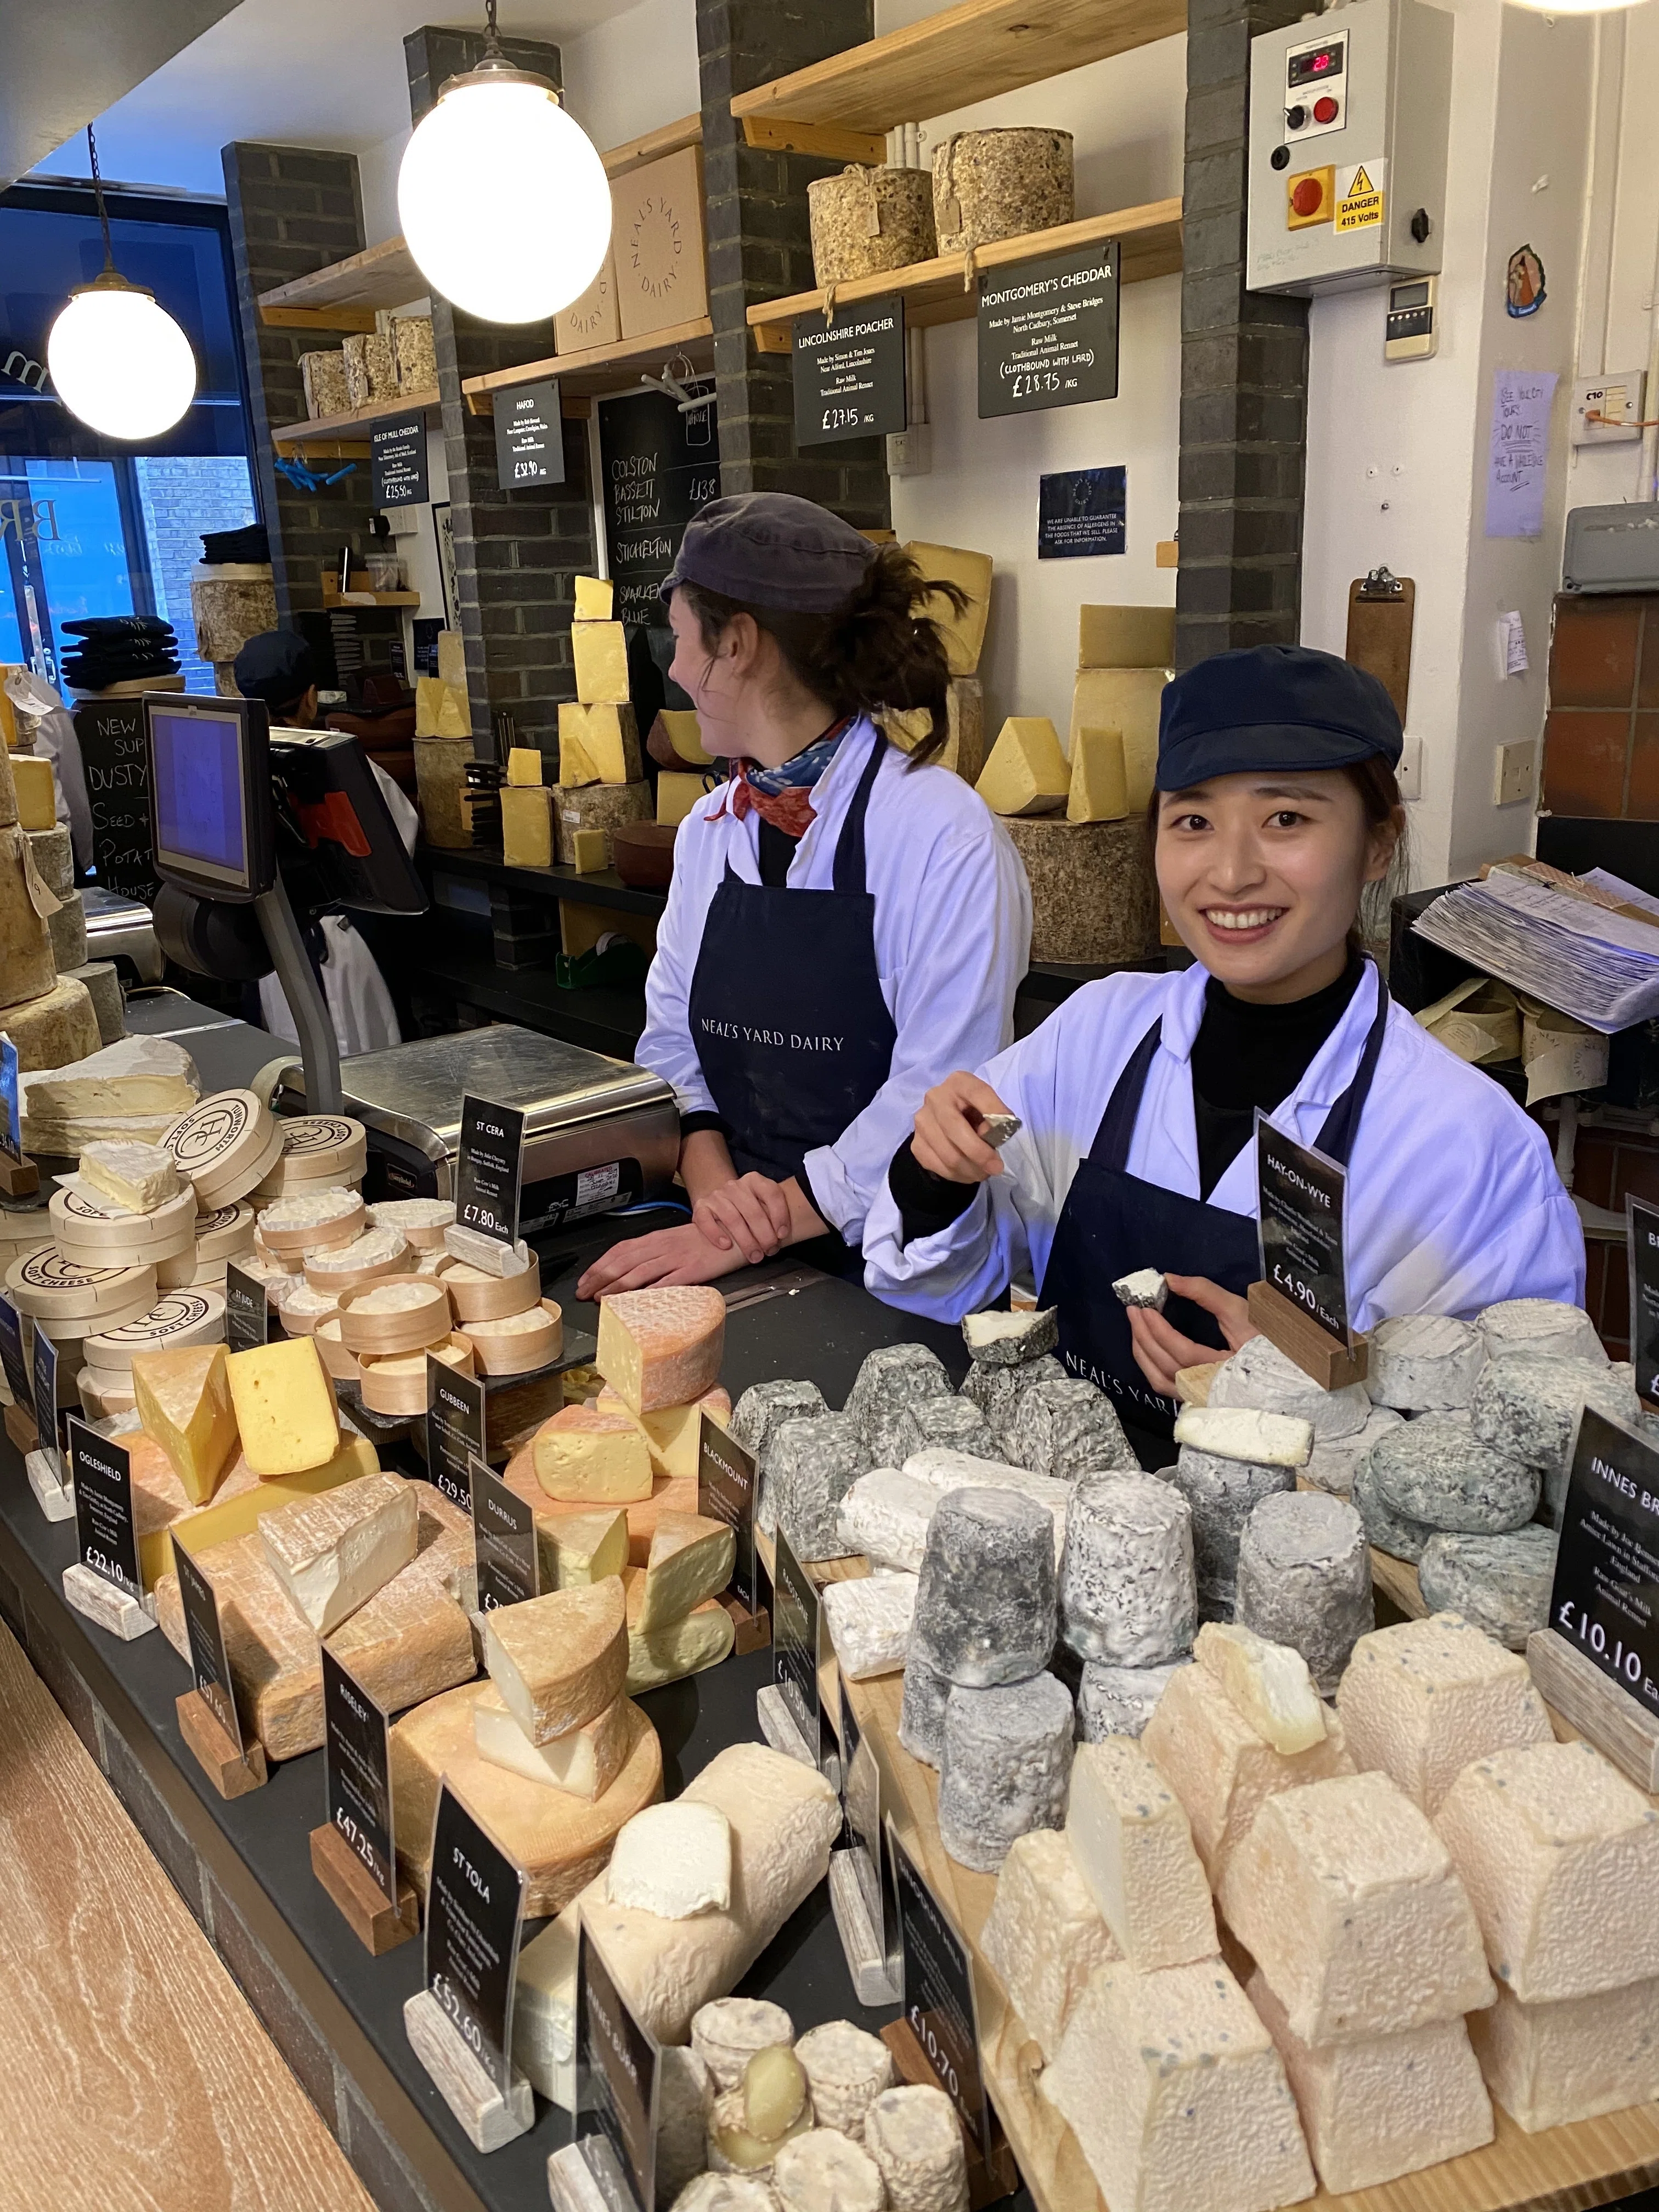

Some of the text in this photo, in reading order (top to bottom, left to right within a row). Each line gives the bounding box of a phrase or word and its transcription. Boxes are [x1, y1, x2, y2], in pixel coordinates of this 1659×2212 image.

[1341, 196, 1379, 213] DANGER
[1341, 211, 1379, 227] 415 Volts
[660, 197, 682, 255] YARD
[641, 265, 676, 297] DAIRY
[981, 265, 1111, 307] MONTGOMERY'S CHEDDAR
[571, 304, 602, 333] DAIRY
[989, 319, 1003, 328] Made
[1004, 318, 1010, 326] by
[1011, 314, 1026, 325] Jamie
[1026, 307, 1059, 320] Montgomery
[1067, 302, 1081, 311] Steve
[1082, 296, 1103, 307] Bridges
[1013, 313, 1077, 334] North Cadbury, Somerset
[799, 318, 894, 348] LINCOLNSHIRE POACHER
[1031, 334, 1057, 346] Raw Milk
[1000, 348, 1094, 379] (CLOTHBOUND WITH LARD)
[1012, 341, 1079, 360] Traditional Animal Rennet
[1013, 372, 1077, 398] £28.75 /KG
[517, 399, 534, 410] HAFOD
[822, 408, 874, 430] £27.15 /KG
[388, 430, 399, 439] MULL
[399, 425, 419, 436] CHEDDAR
[612, 453, 658, 481] COLSTON
[614, 478, 715, 505] BASSETT £138
[616, 498, 660, 526] STILTON
[621, 607, 650, 626] BLUE
[97, 718, 136, 736] NEW
[88, 764, 146, 790] DUSTY
[701, 1018, 844, 1052] NEAL'S YARD DAIRY
[215, 1104, 245, 1152] TUNWORTH
[476, 1121, 504, 1138] ST CERA
[1267, 1154, 1330, 1207] HAY-ON-WYE
[464, 1204, 509, 1234] £7.80 Each
[27, 1266, 94, 1286] SOFT CHEESE
[236, 1289, 253, 1308] ST JUDE
[150, 1300, 204, 1336] SOFT CHEESE
[1066, 1350, 1123, 1395] NEAL'S
[439, 1389, 470, 1414] GUBBEEN
[80, 1451, 121, 1482] OGLESHIELD
[704, 1442, 748, 1490] BLACKMOUNT
[1591, 1457, 1637, 1499] INNES
[438, 1475, 472, 1509] £29.50
[488, 1499, 517, 1530] DURRUS
[783, 1568, 808, 1624] RAGSTONE
[1559, 1601, 1641, 1682] £10.10
[340, 1683, 366, 1722] RISELEY
[453, 1847, 490, 1904] ST TOLA
[911, 2005, 958, 2097] £10.70
